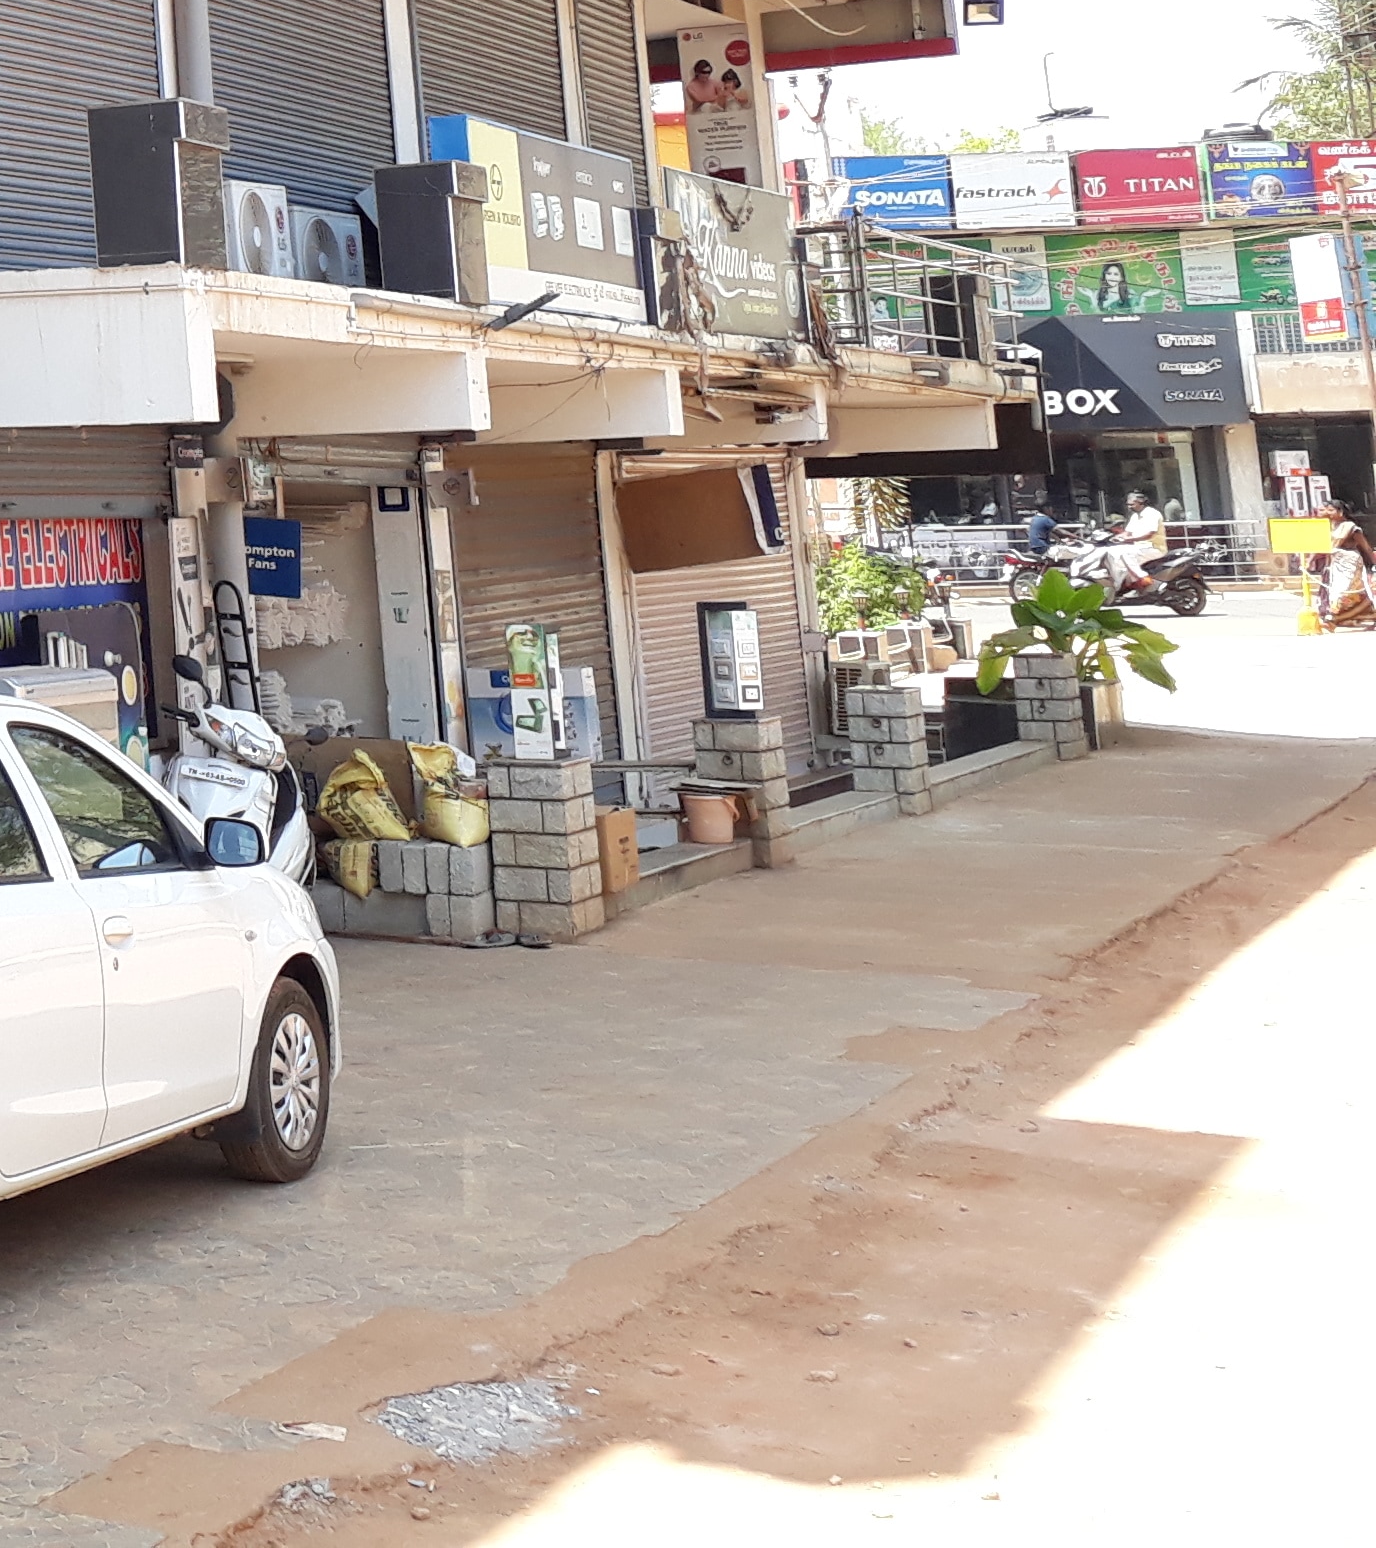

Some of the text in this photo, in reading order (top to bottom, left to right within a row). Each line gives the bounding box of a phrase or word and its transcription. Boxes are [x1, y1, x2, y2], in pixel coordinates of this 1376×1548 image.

[1124, 176, 1195, 193] TITAN
[854, 188, 946, 207] SONATA
[955, 185, 1037, 200] fastrack
[1174, 334, 1216, 346] TITAN
[1164, 389, 1225, 402] SONATA
[15, 517, 142, 590] ELECTRICALS
[245, 545, 295, 559] ompton
[248, 558, 277, 571] Fans
